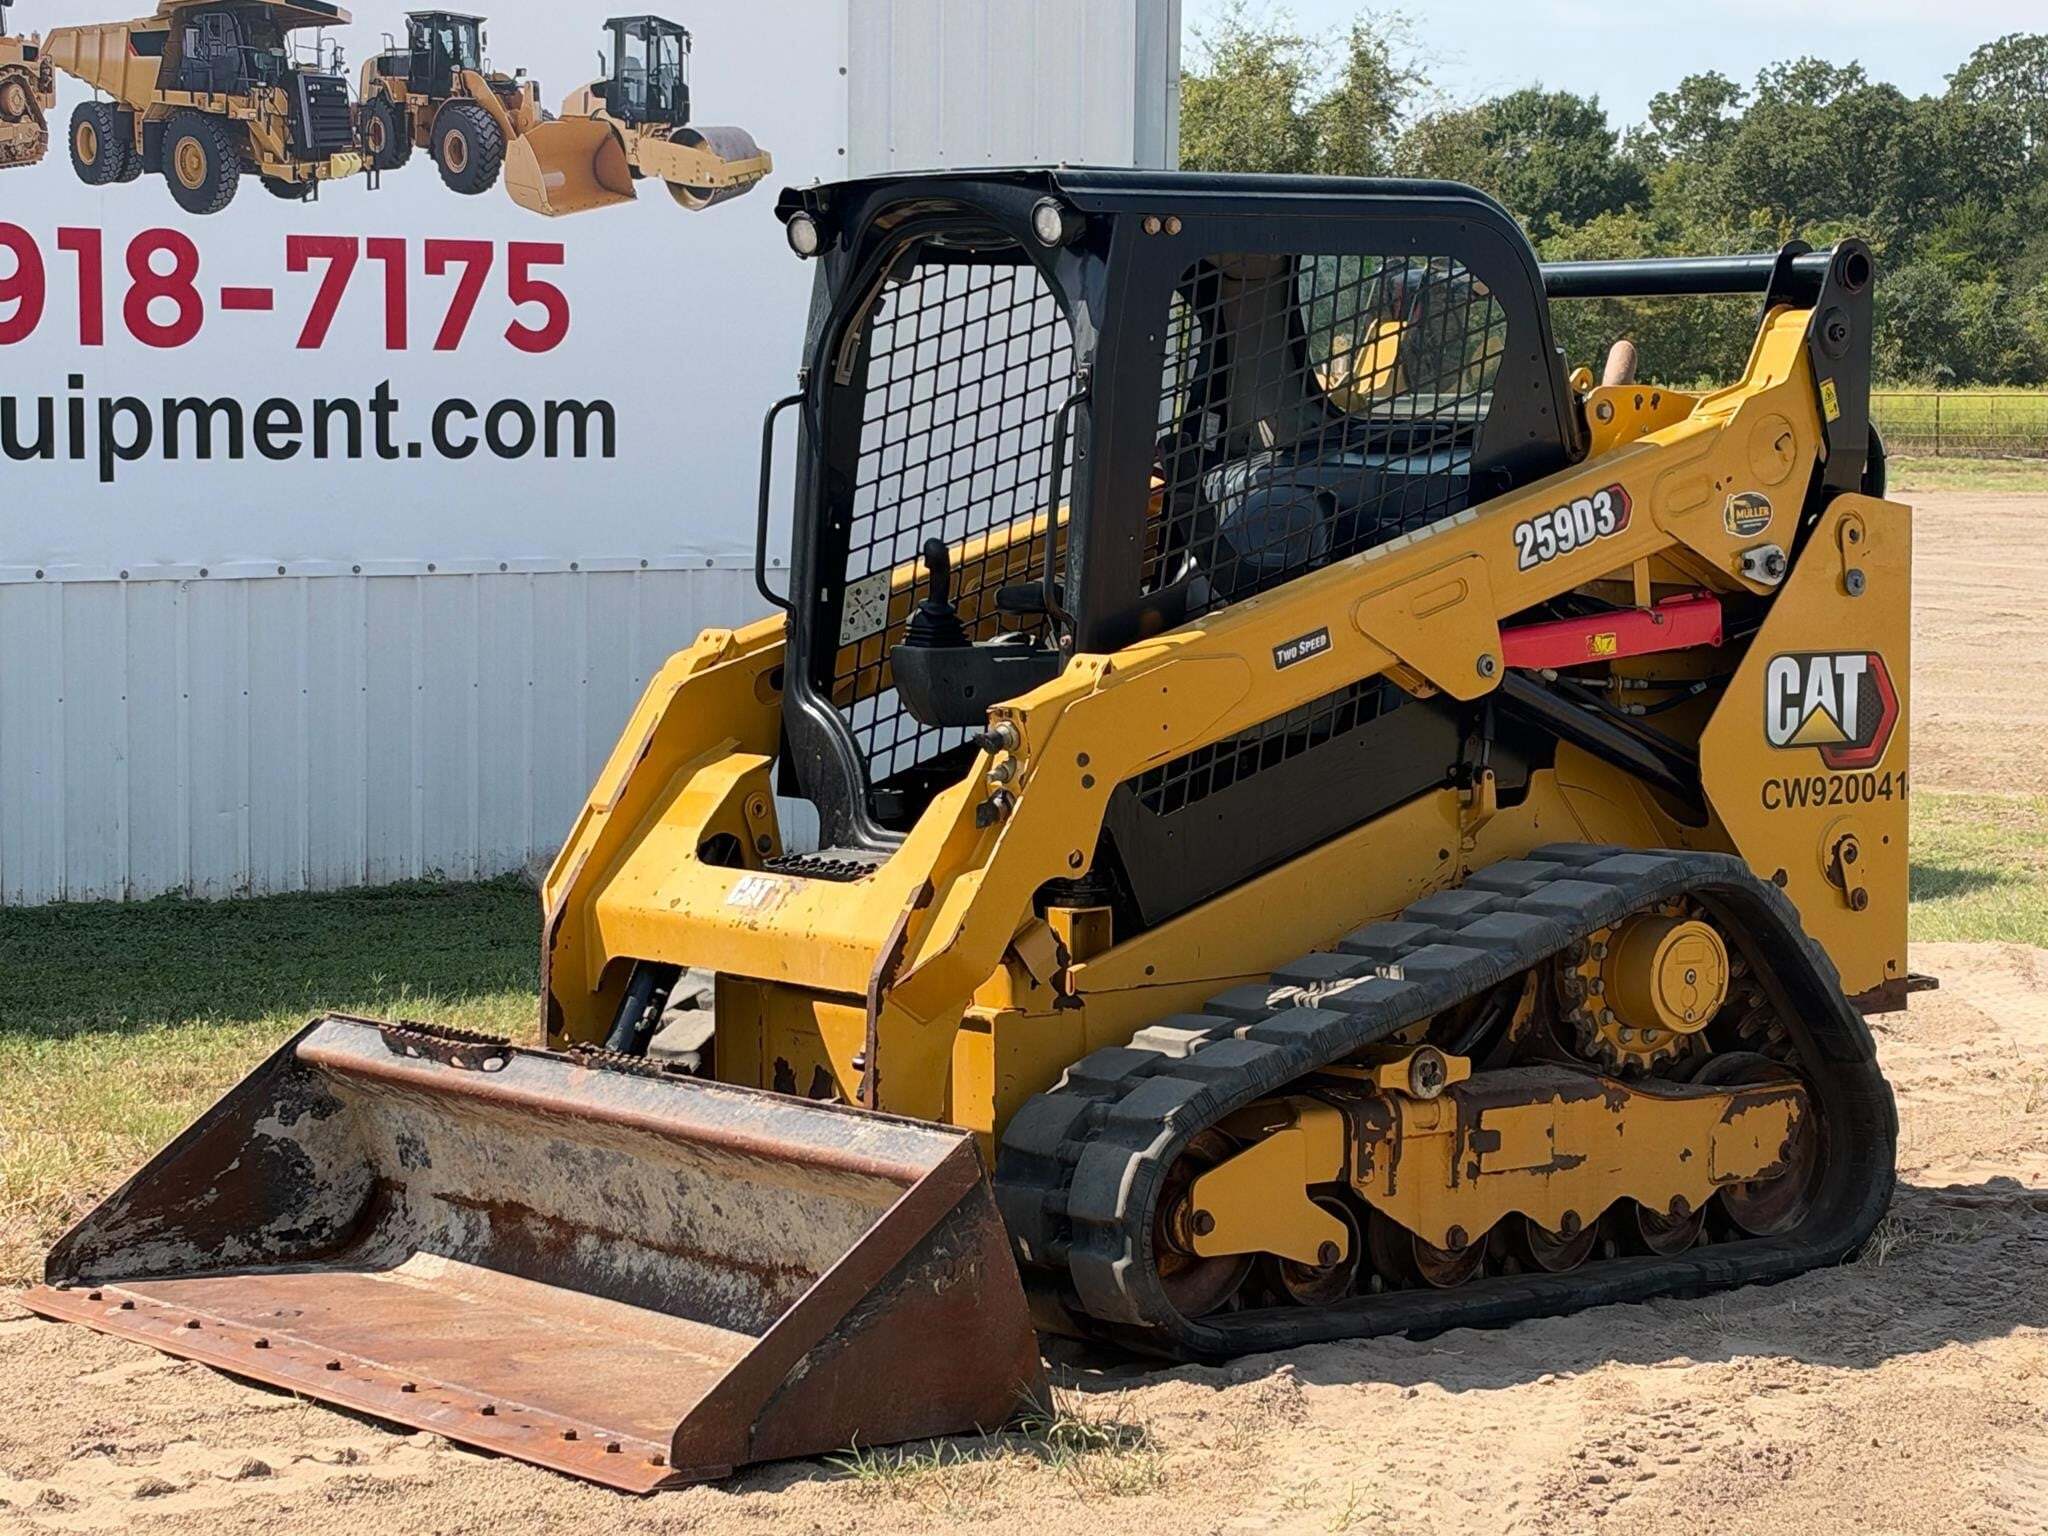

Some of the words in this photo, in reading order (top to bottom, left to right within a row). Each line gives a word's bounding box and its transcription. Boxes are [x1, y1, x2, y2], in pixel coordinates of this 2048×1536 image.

[0, 222, 570, 354] 918-7175
[0, 373, 617, 483] uipment.com
[1515, 491, 1616, 570] 259D3
[1767, 654, 1868, 746] CAT
[1761, 770, 1909, 811] CW920041
